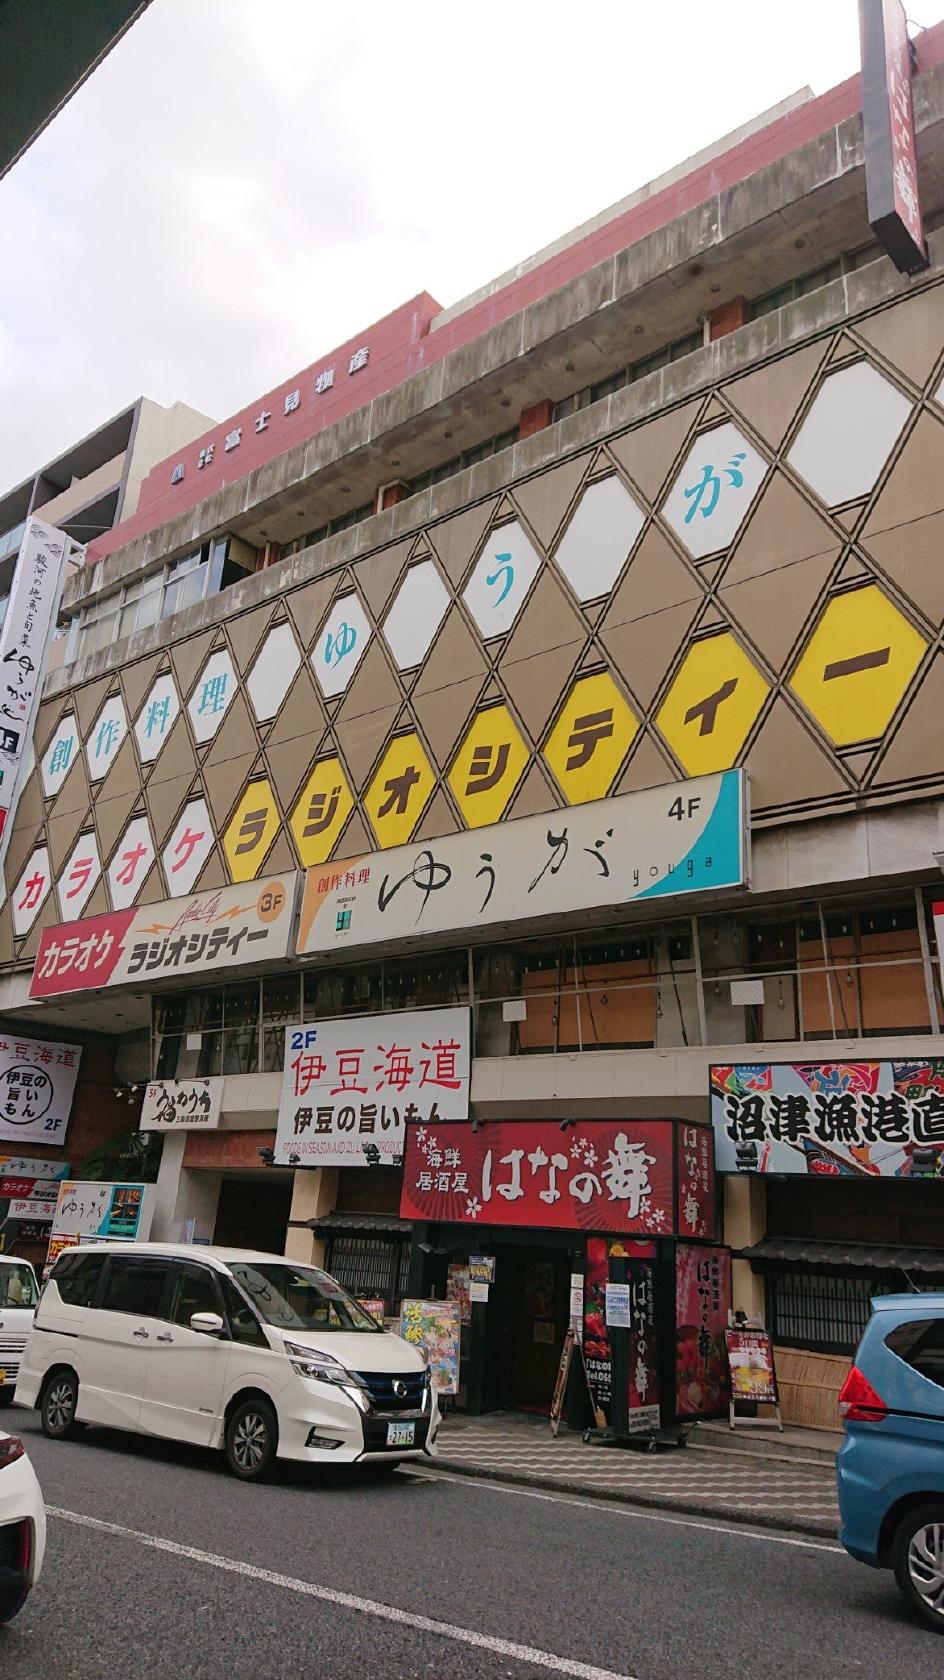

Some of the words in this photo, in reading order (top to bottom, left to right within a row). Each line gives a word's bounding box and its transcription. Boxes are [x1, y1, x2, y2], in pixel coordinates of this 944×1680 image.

[49, 672, 228, 776] 創作料理
[18, 827, 205, 911] カラオケ
[234, 647, 890, 856] ラジオシティー
[668, 796, 701, 821] 4F
[317, 867, 370, 894] 創作料理
[378, 828, 614, 926] ゆうが
[633, 857, 713, 887] youga
[260, 893, 282, 912] 3F
[37, 928, 115, 980] カラオケ
[126, 926, 269, 974] ラジオシティー
[291, 1030, 317, 1050] 2F
[291, 1038, 462, 1097] 伊豆海道
[44, 1119, 62, 1131] 2F
[427, 1148, 461, 1168] 海鮮
[482, 1132, 656, 1219] はなの舞
[416, 1172, 469, 1193] 居酒屋
[683, 1127, 702, 1233] はなの舞
